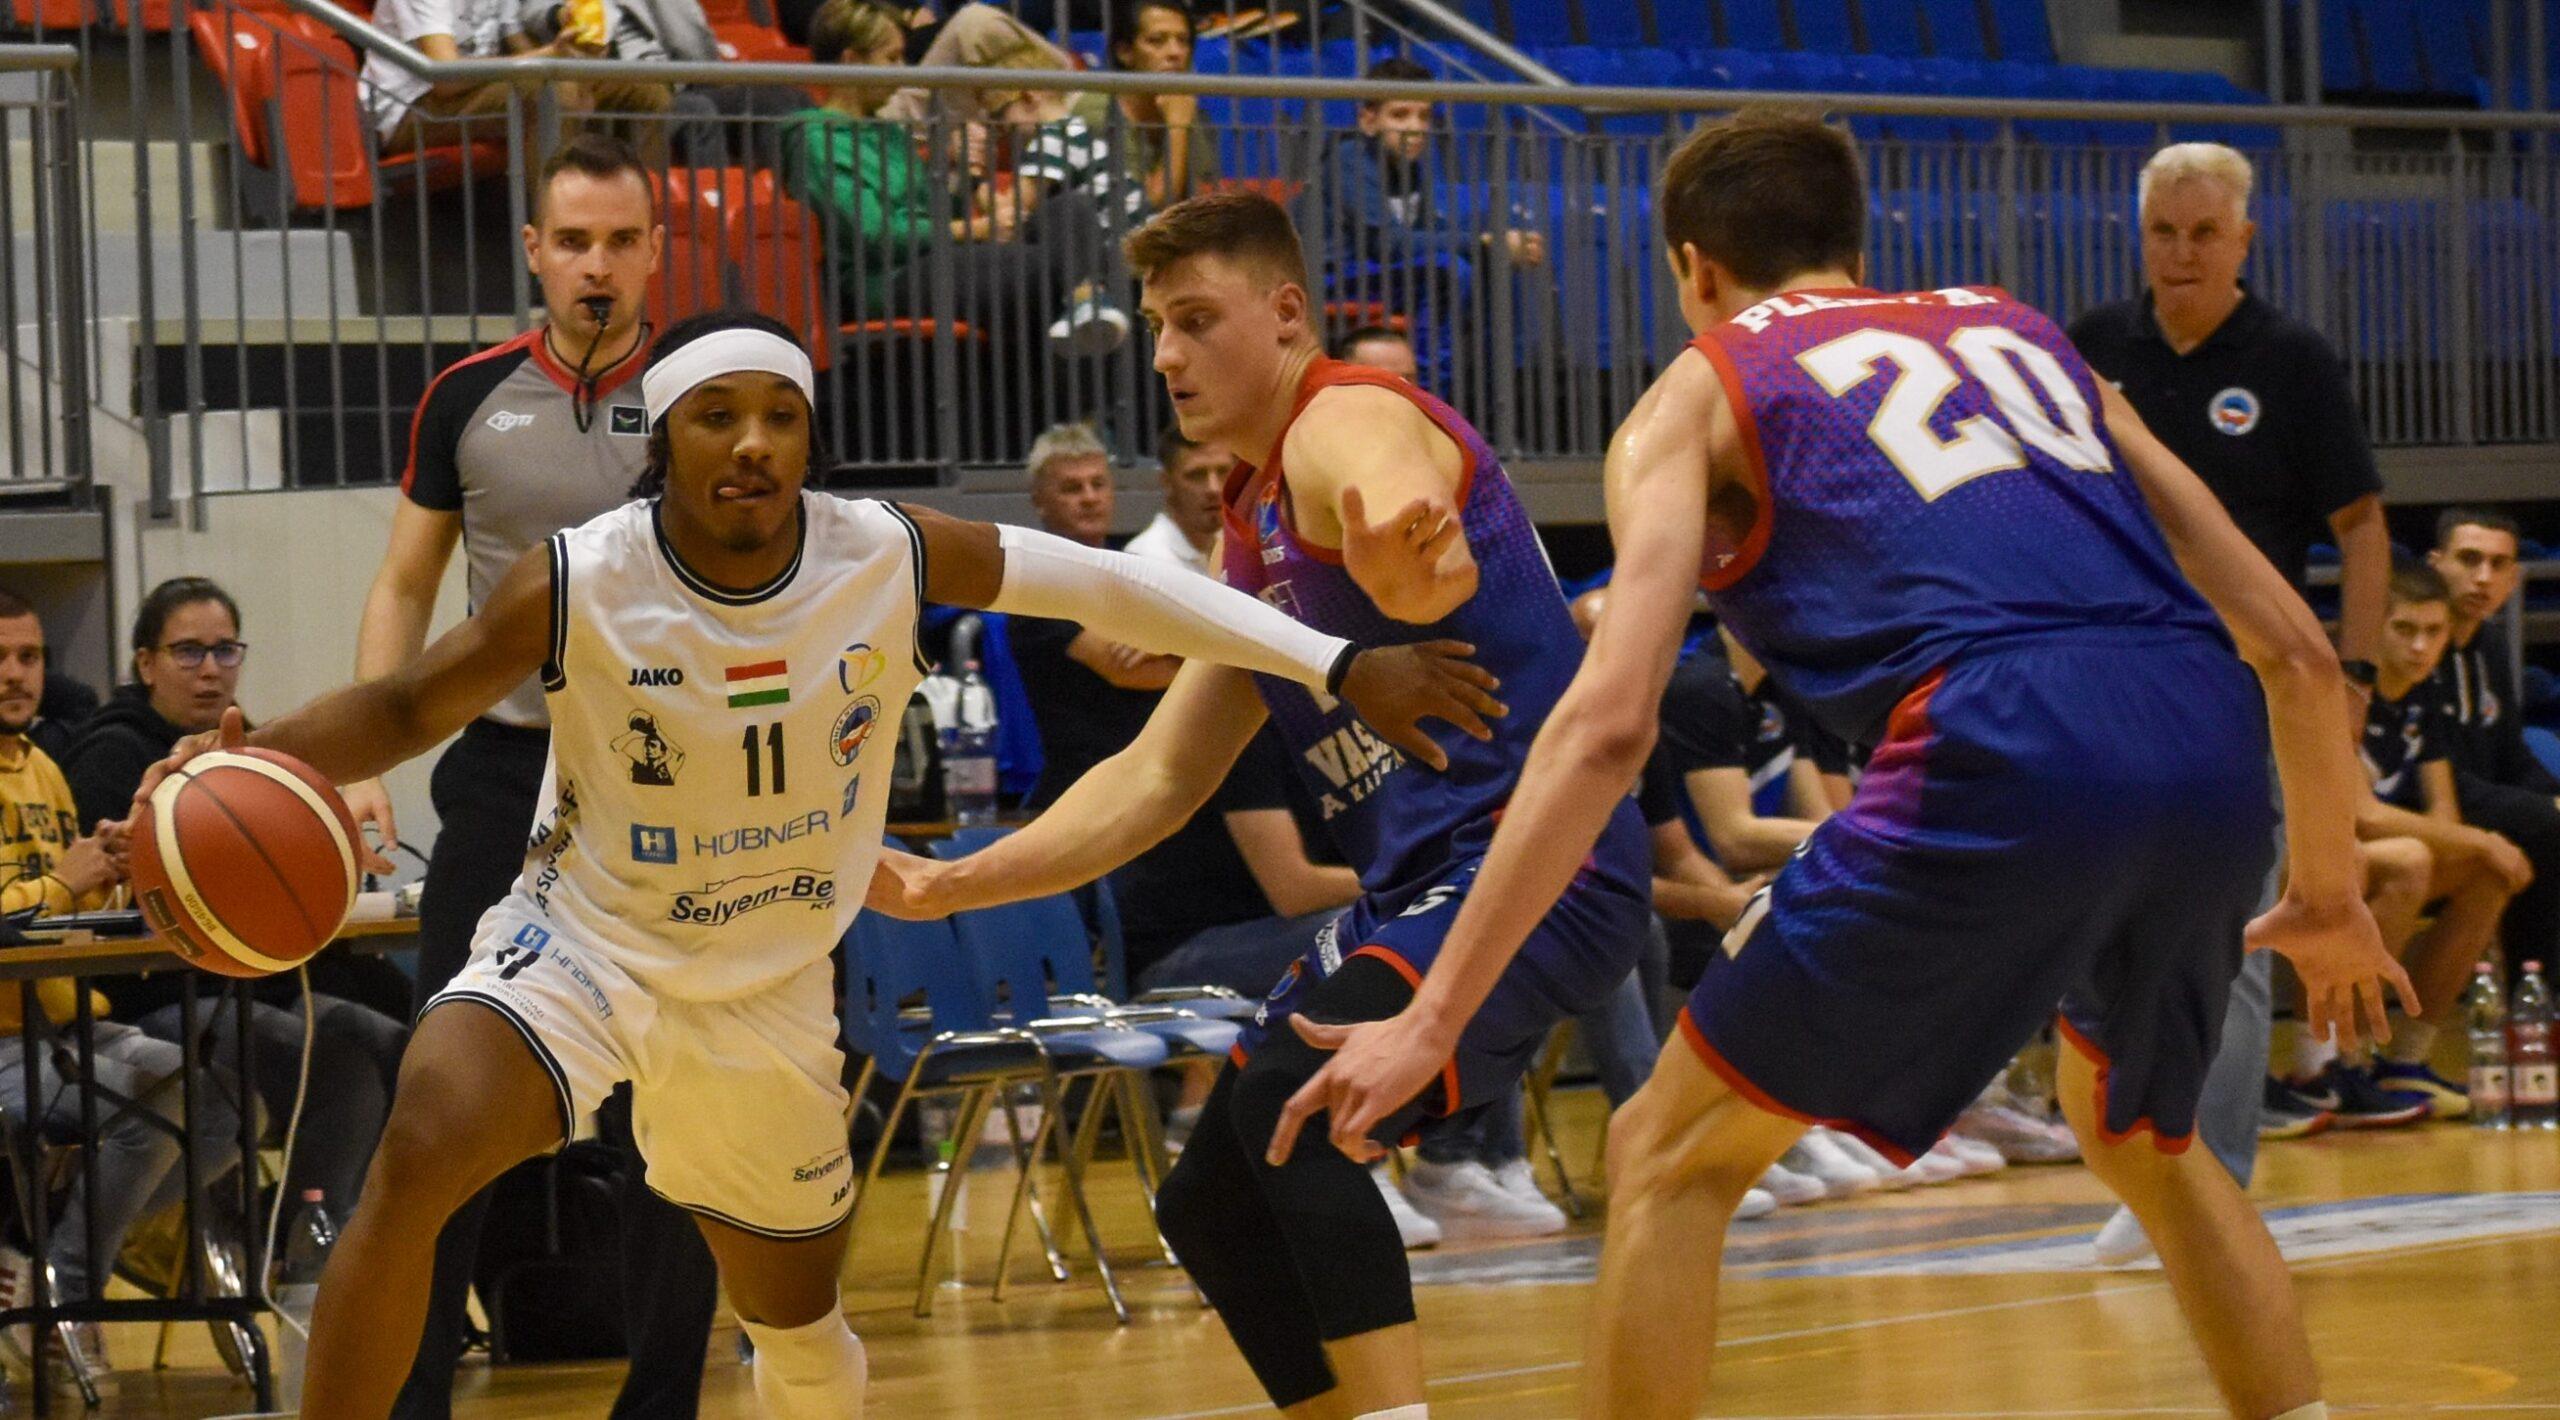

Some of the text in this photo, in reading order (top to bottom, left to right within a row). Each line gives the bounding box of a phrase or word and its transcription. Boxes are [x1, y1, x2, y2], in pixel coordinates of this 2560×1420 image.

[1794, 327, 2114, 503] 20
[628, 668, 685, 686] JAKO
[742, 722, 786, 797] 11
[694, 810, 830, 858] HÜBNER
